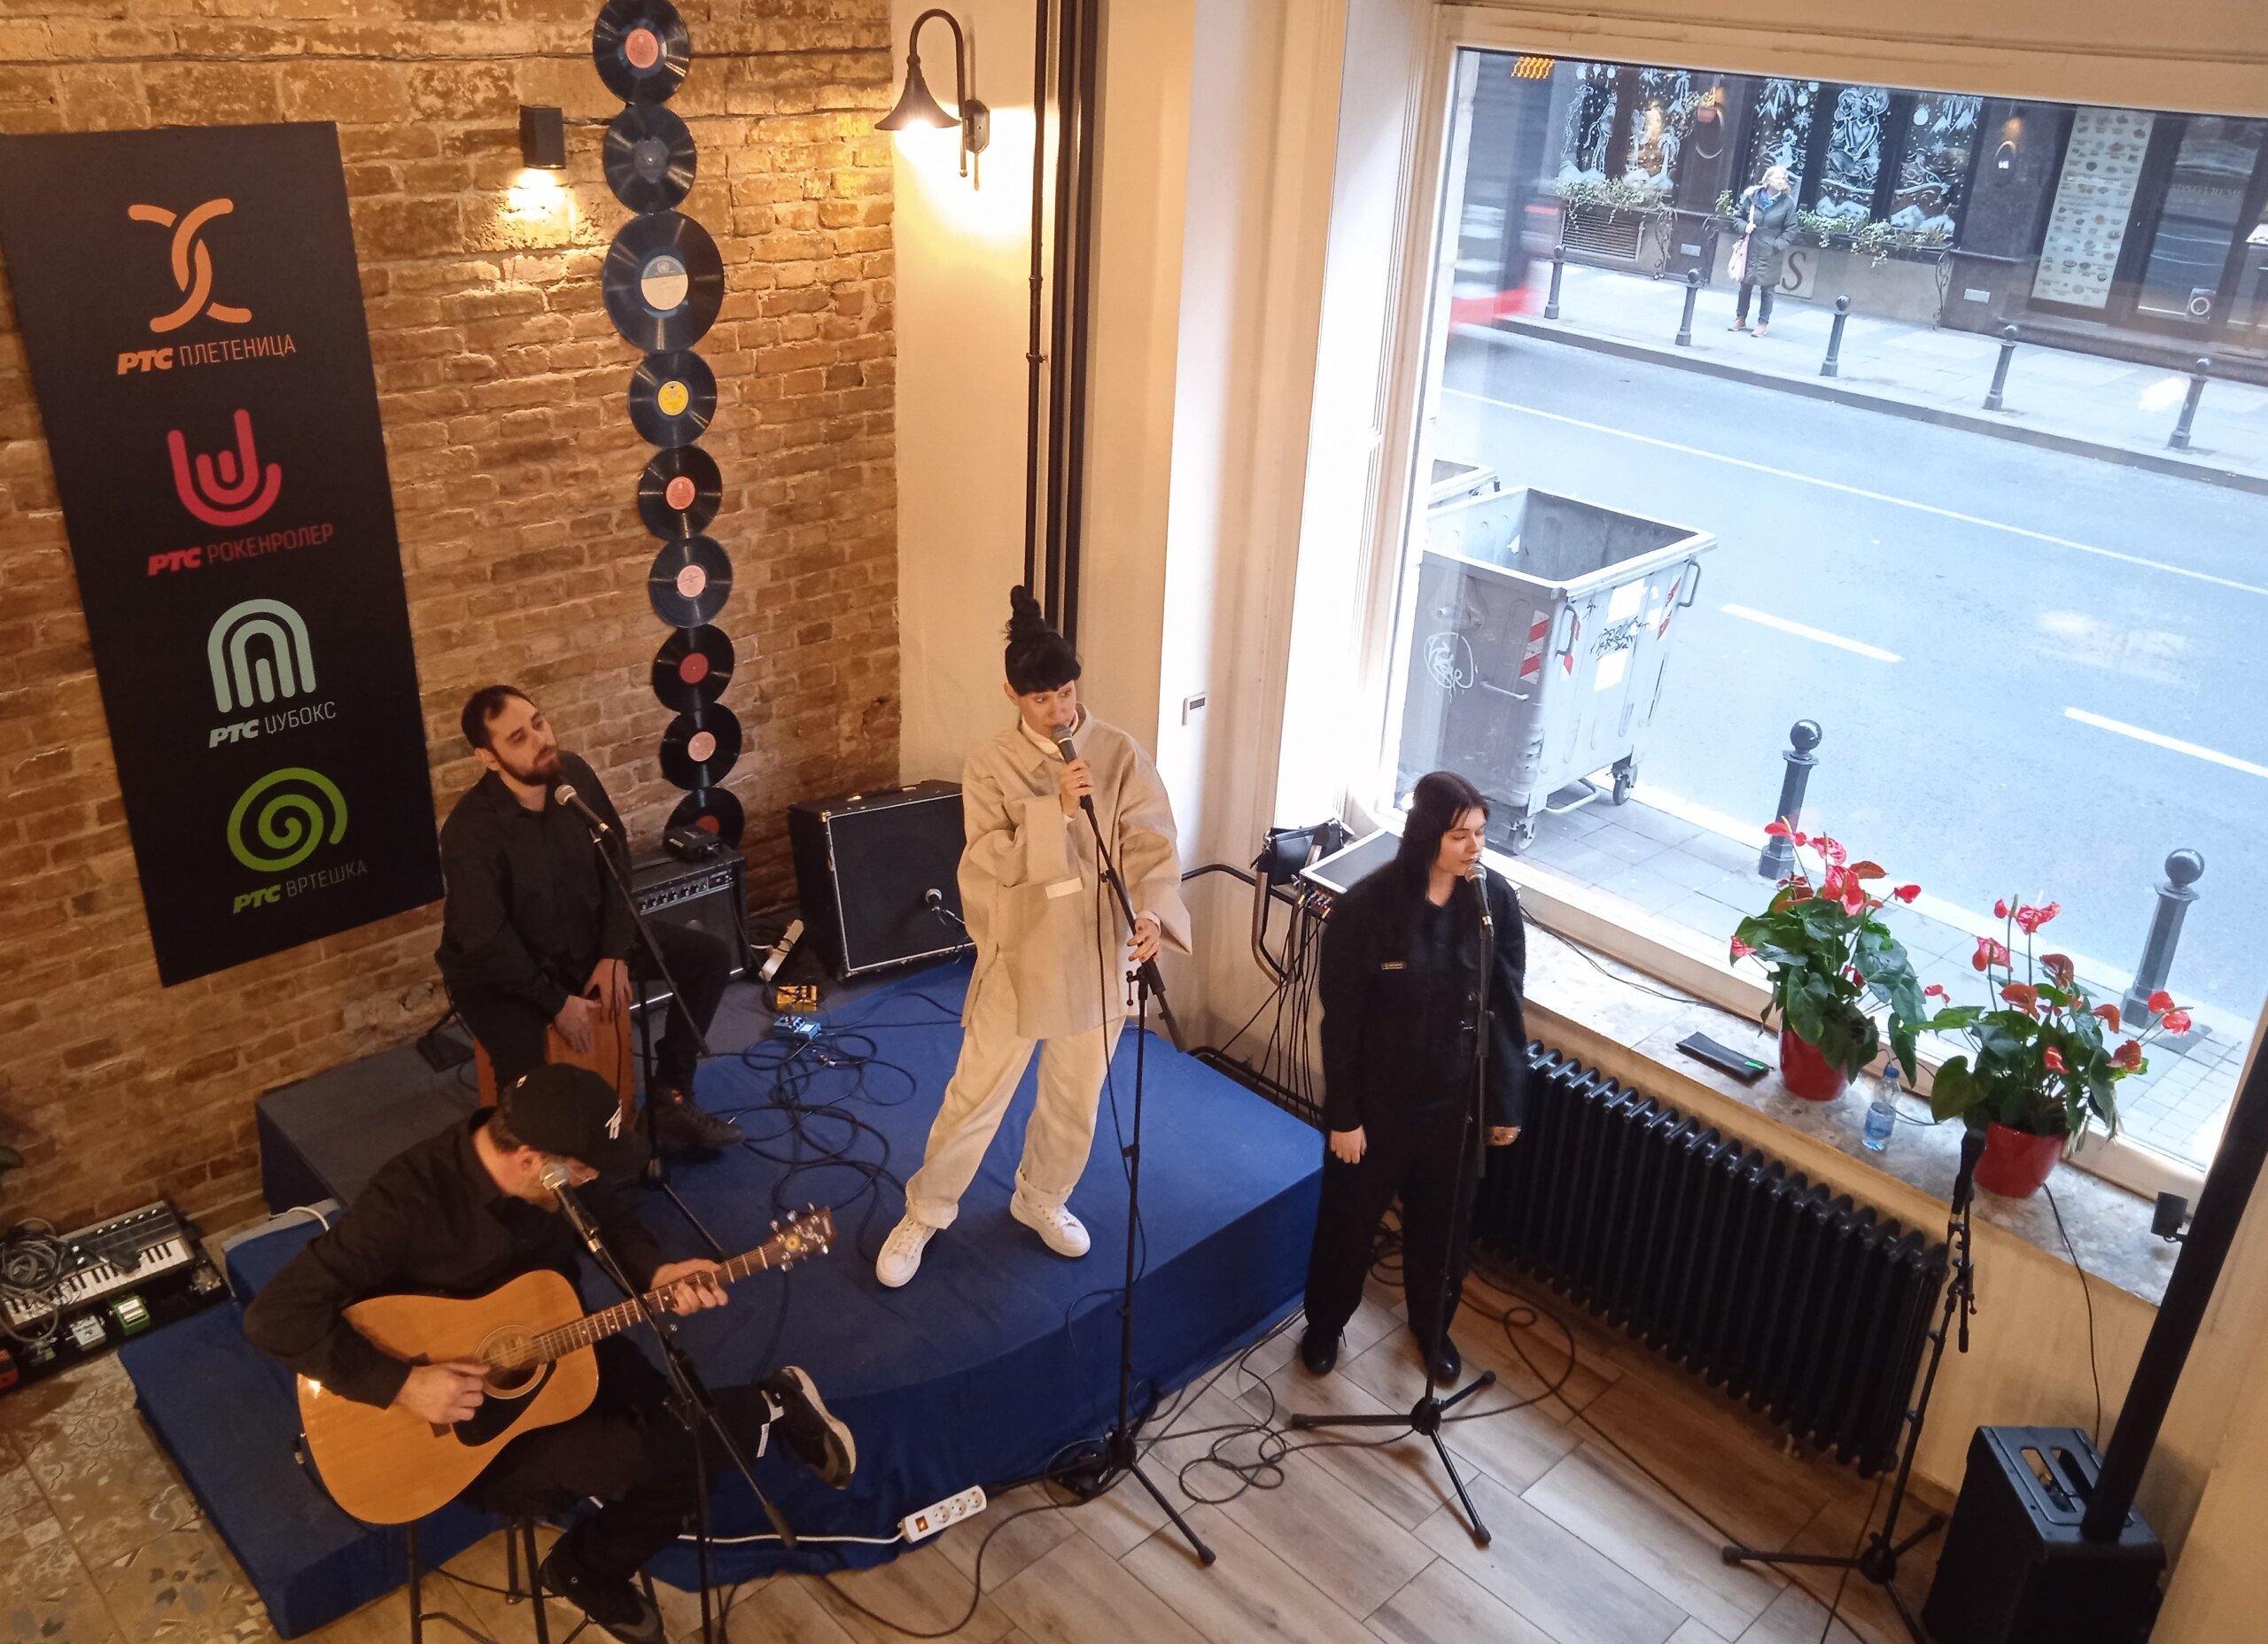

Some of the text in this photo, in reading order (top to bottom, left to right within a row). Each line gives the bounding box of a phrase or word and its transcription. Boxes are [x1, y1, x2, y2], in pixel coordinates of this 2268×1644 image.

[1781, 251, 1806, 291] S
[118, 334, 297, 375] РТС ПЛЕТЕНИЦА
[148, 523, 334, 576] РТС РОКЕНРОЛЕР
[209, 701, 337, 748] РТС ЏУБОКС
[233, 859, 369, 914] РТС ВРТЕШКА
